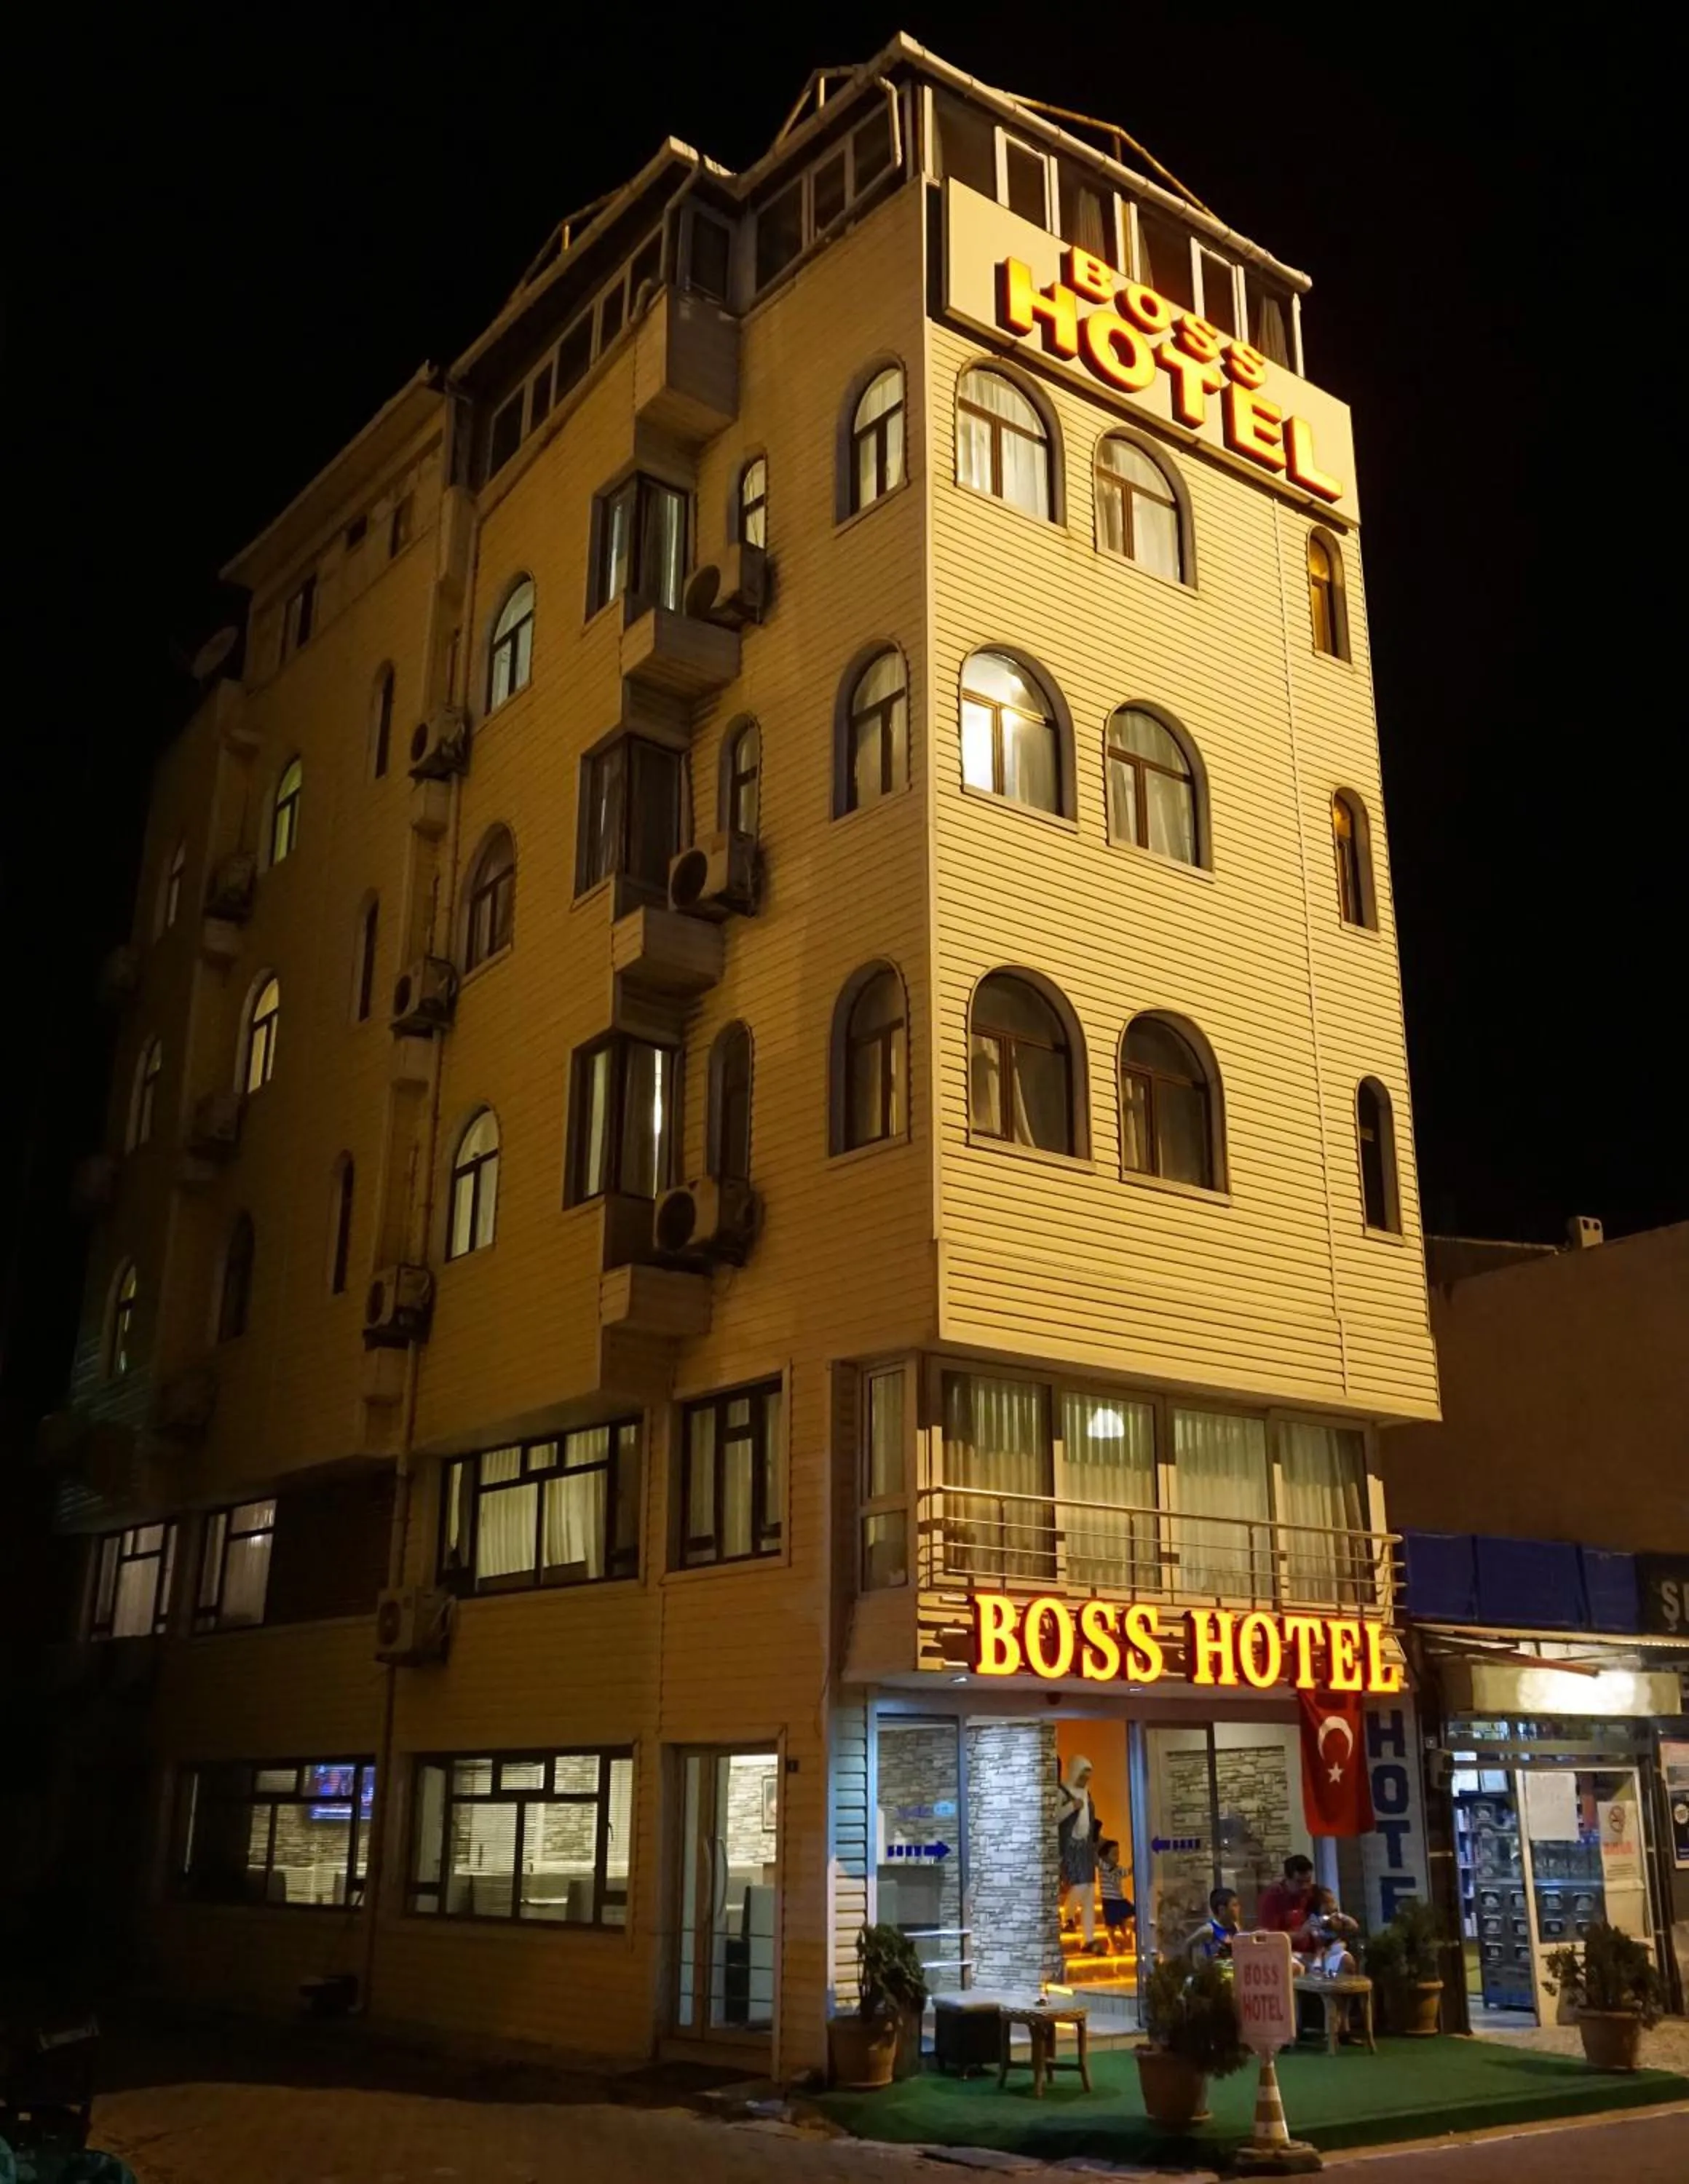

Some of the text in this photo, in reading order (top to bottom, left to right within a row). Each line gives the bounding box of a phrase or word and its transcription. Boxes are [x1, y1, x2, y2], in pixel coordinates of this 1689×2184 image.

[1058, 245, 1267, 389] BOSS
[995, 256, 1344, 502] HOTEL
[970, 1594, 1402, 1693] BOSS HOTEL
[1366, 1709, 1417, 1923] HOTE
[1243, 1962, 1280, 1985] BOSS
[1243, 1993, 1283, 2022] HOTEL
